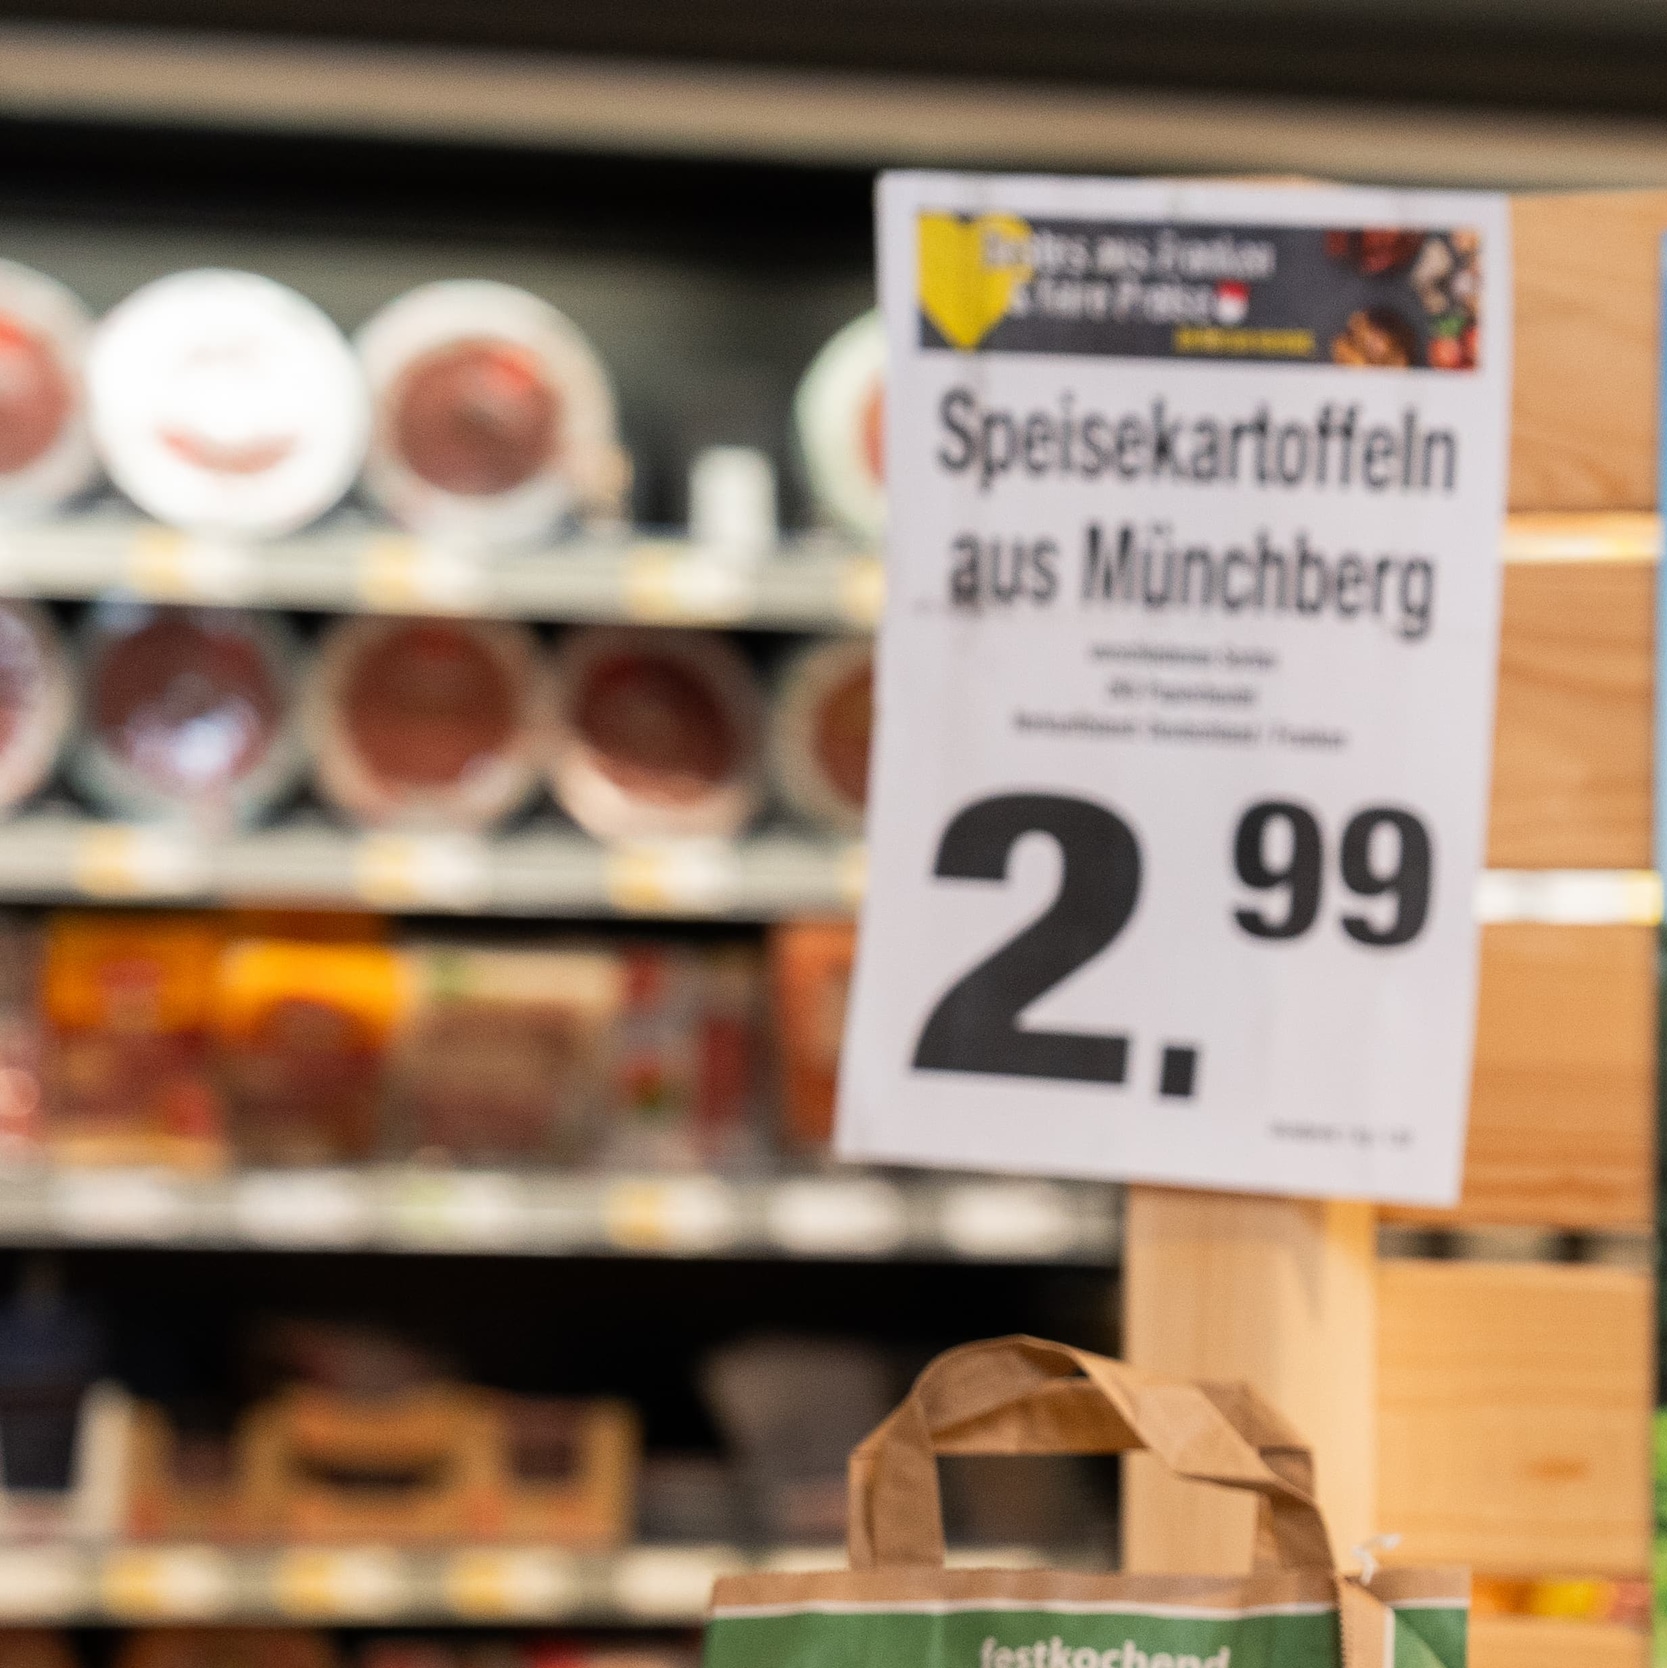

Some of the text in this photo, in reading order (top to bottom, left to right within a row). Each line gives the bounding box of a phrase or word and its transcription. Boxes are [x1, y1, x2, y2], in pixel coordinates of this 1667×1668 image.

[935, 389, 1458, 491] Speisekartoffeln
[950, 521, 1434, 640] aus Münchberg
